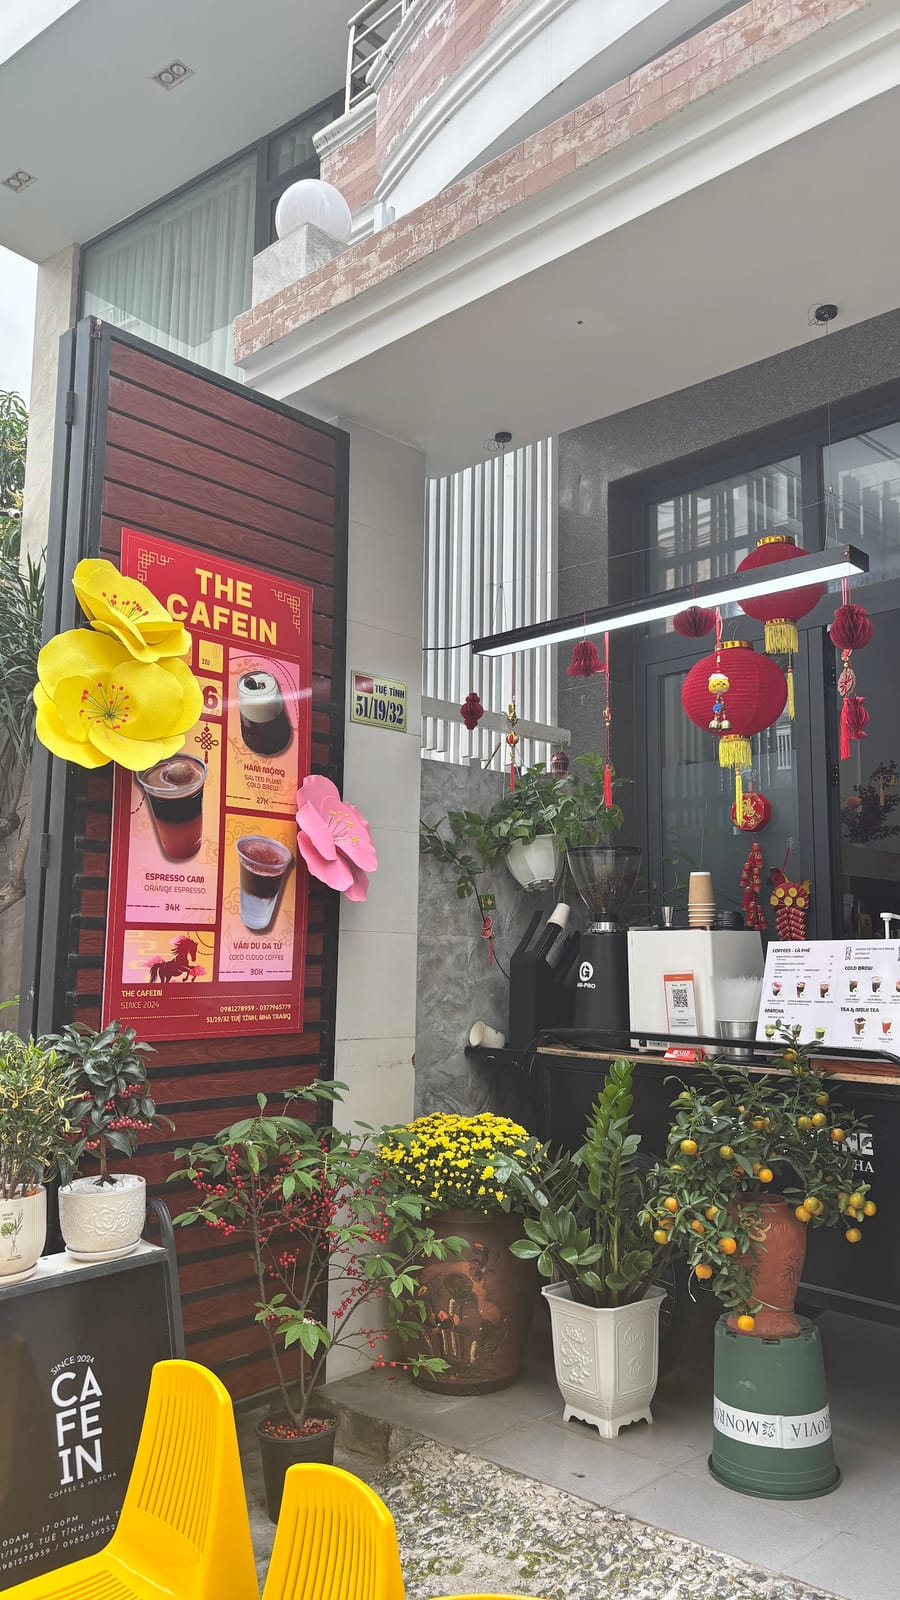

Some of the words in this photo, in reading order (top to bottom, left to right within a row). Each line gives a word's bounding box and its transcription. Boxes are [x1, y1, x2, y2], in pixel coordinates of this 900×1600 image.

[195, 568, 252, 608] THE
[166, 593, 277, 646] CAFEIN
[375, 684, 387, 696] TUỆ
[356, 695, 404, 724] 51/19/32
[144, 884, 173, 894] ORANGE
[174, 885, 206, 894] ESPRESSO
[145, 872, 185, 883] ESPRESSO
[186, 875, 205, 883] CAM
[50, 1356, 75, 1376] SINCE
[76, 1354, 95, 1364] 2024
[51, 1365, 103, 1407] CA
[56, 1401, 102, 1447] FE
[790, 1414, 832, 1439] ROVIA
[58, 1438, 102, 1485] IN
[48, 1485, 76, 1499] COFFEE
[88, 1472, 117, 1485] MATCHA
[0, 1542, 34, 1559] 1/19/32
[92, 1515, 110, 1526] NHA
[0, 1548, 50, 1571] 981278959
